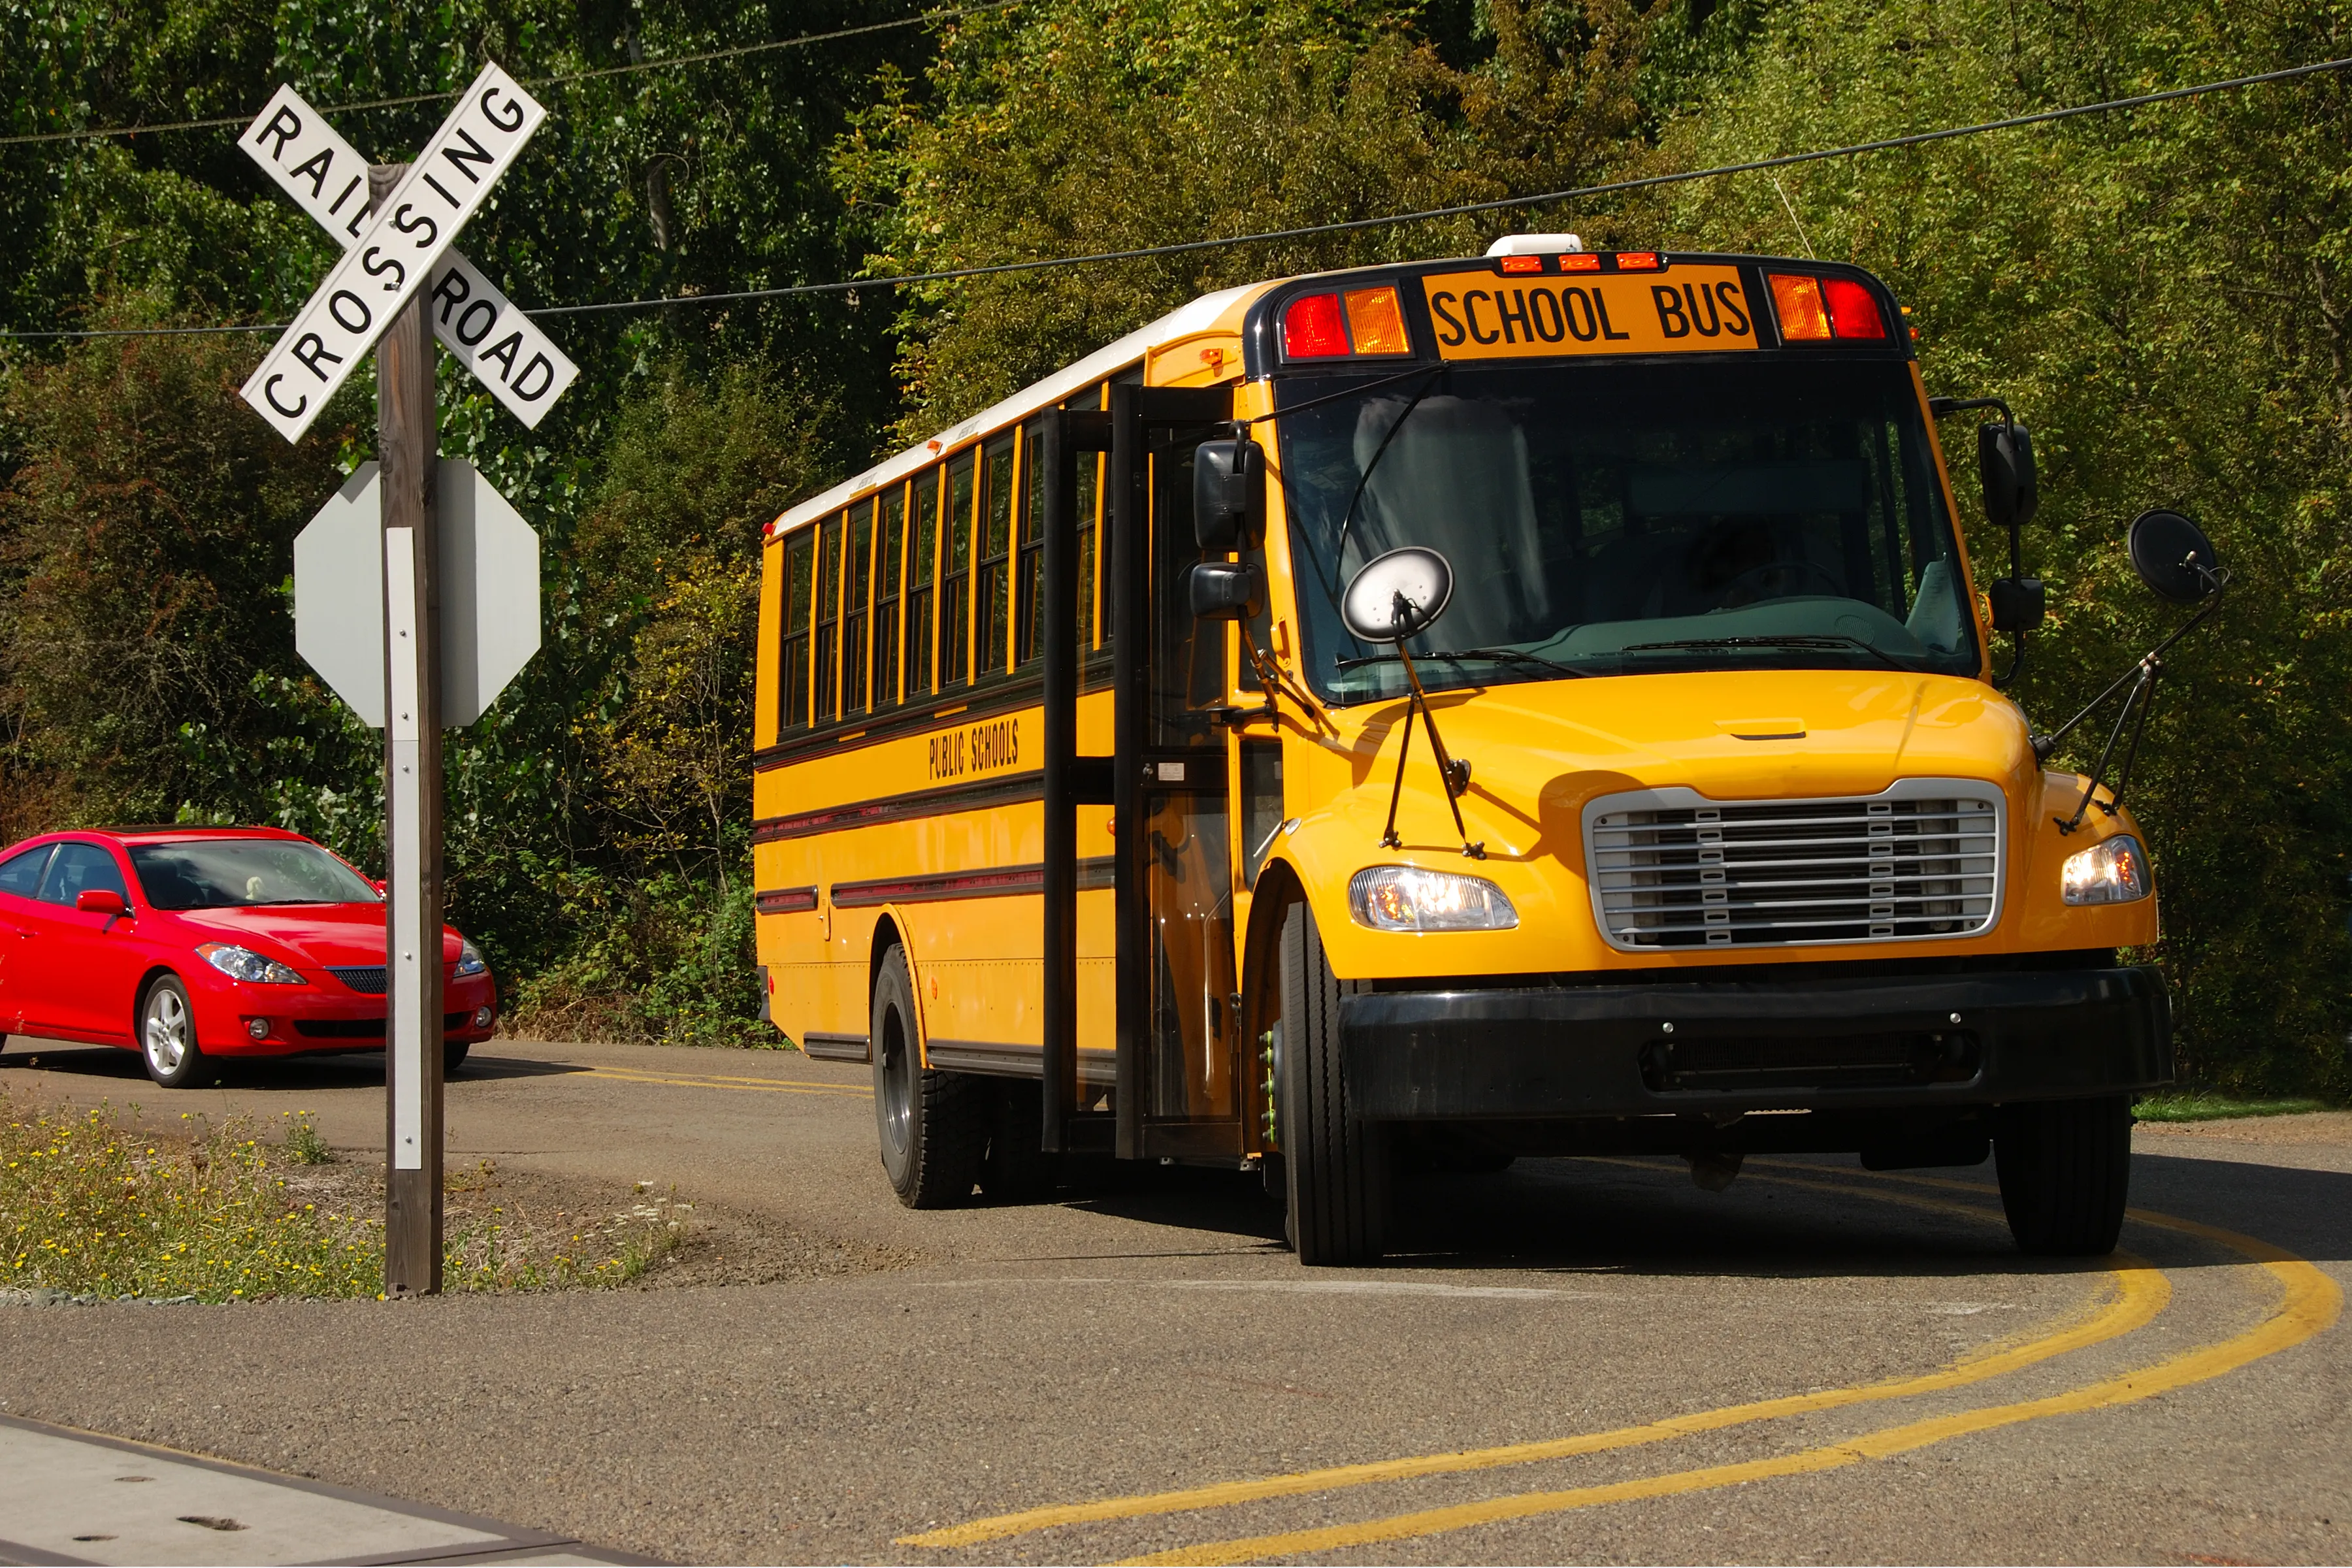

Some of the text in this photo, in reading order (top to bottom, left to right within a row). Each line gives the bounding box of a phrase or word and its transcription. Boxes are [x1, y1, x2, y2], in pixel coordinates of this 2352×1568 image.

[264, 87, 525, 419] CROSSING
[432, 267, 555, 402] ROAD
[1431, 280, 1751, 346] SCHOOL BUS
[929, 718, 1019, 780] PUBLIC SCHOOLS
